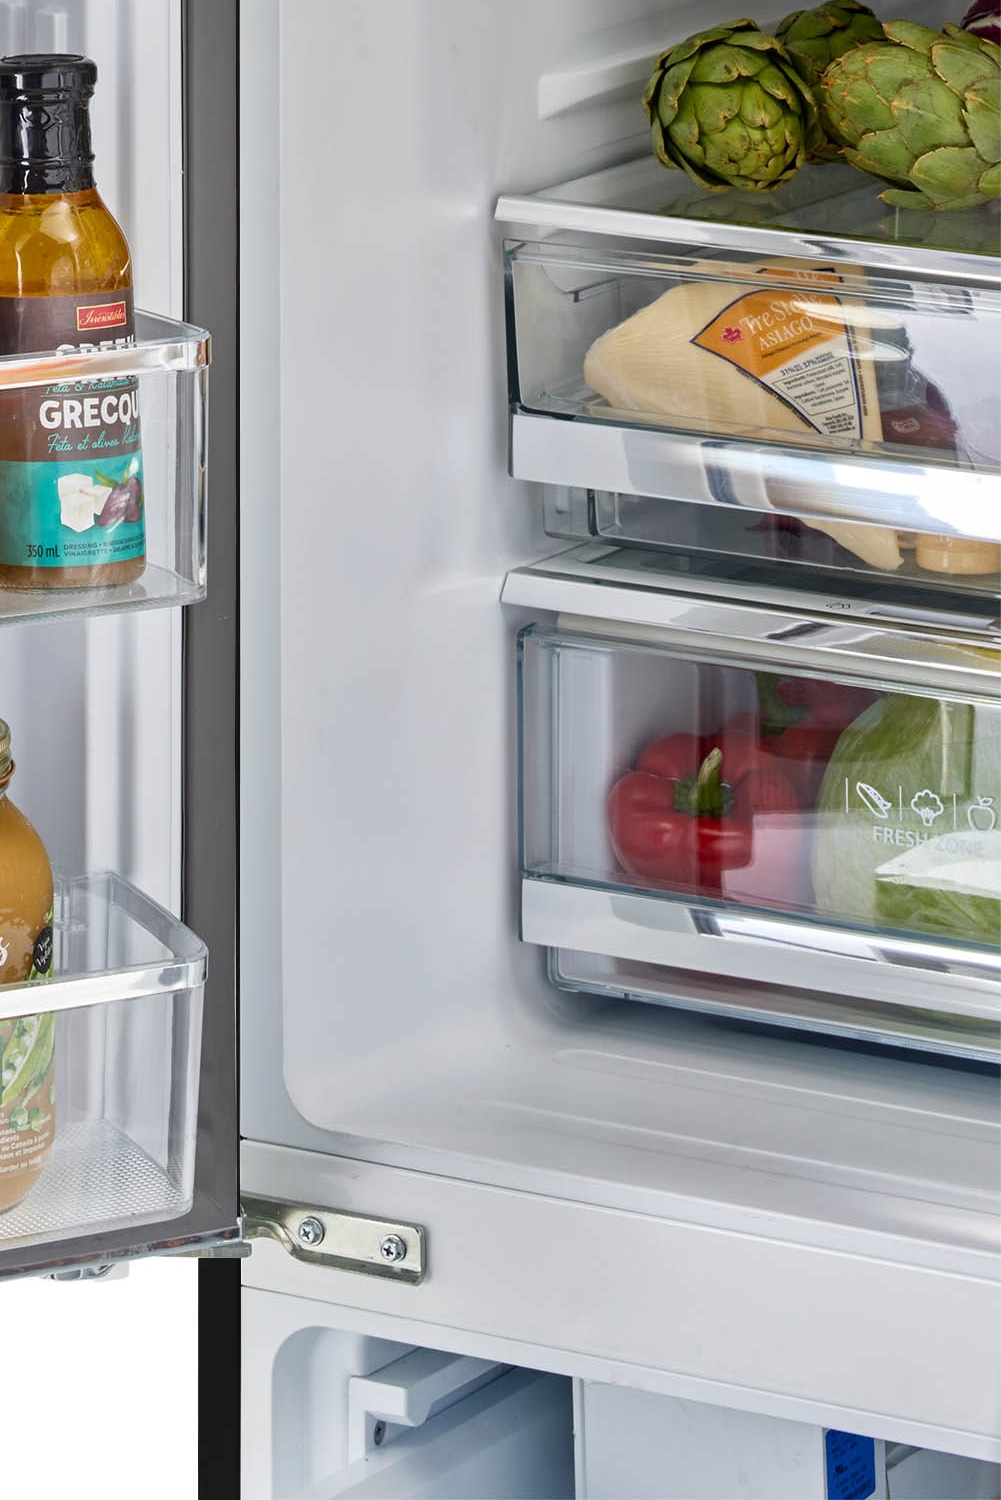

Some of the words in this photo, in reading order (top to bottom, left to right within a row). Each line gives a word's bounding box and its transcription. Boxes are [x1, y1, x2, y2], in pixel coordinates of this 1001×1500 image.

[758, 315, 814, 351] ASIAGO
[26, 544, 43, 558] 350
[45, 544, 60, 558] mL
[872, 825, 929, 848] FRESH
